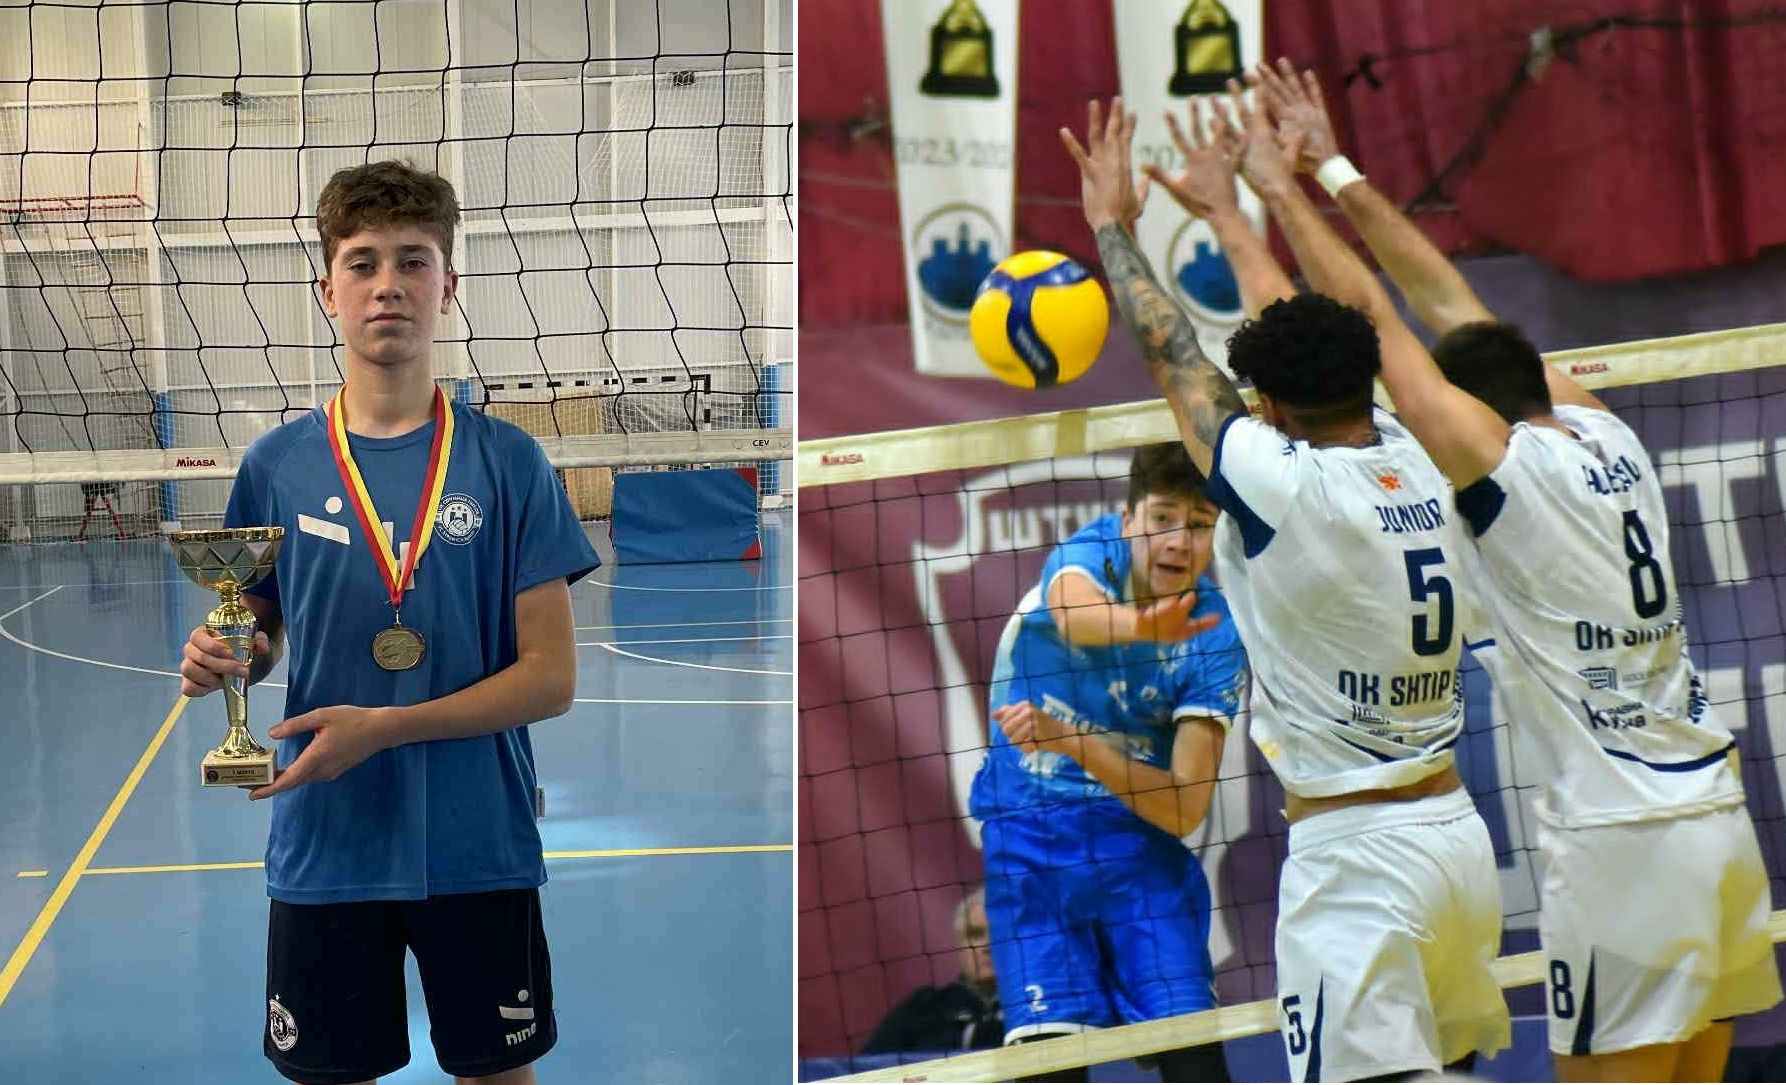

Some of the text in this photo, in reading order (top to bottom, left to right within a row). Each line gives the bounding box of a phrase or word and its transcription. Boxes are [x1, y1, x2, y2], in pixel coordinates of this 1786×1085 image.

[752, 439, 770, 447] CEV
[1375, 498, 1446, 533] JUNIOR
[1622, 509, 1667, 619] 8
[1403, 547, 1454, 657] 5
[1576, 620, 1614, 651] OK
[1338, 669, 1379, 706] OK
[1390, 669, 1451, 706] SHTIP
[1024, 984, 1048, 1012] 2
[1550, 959, 1576, 1019] 8
[1282, 994, 1307, 1056] 5
